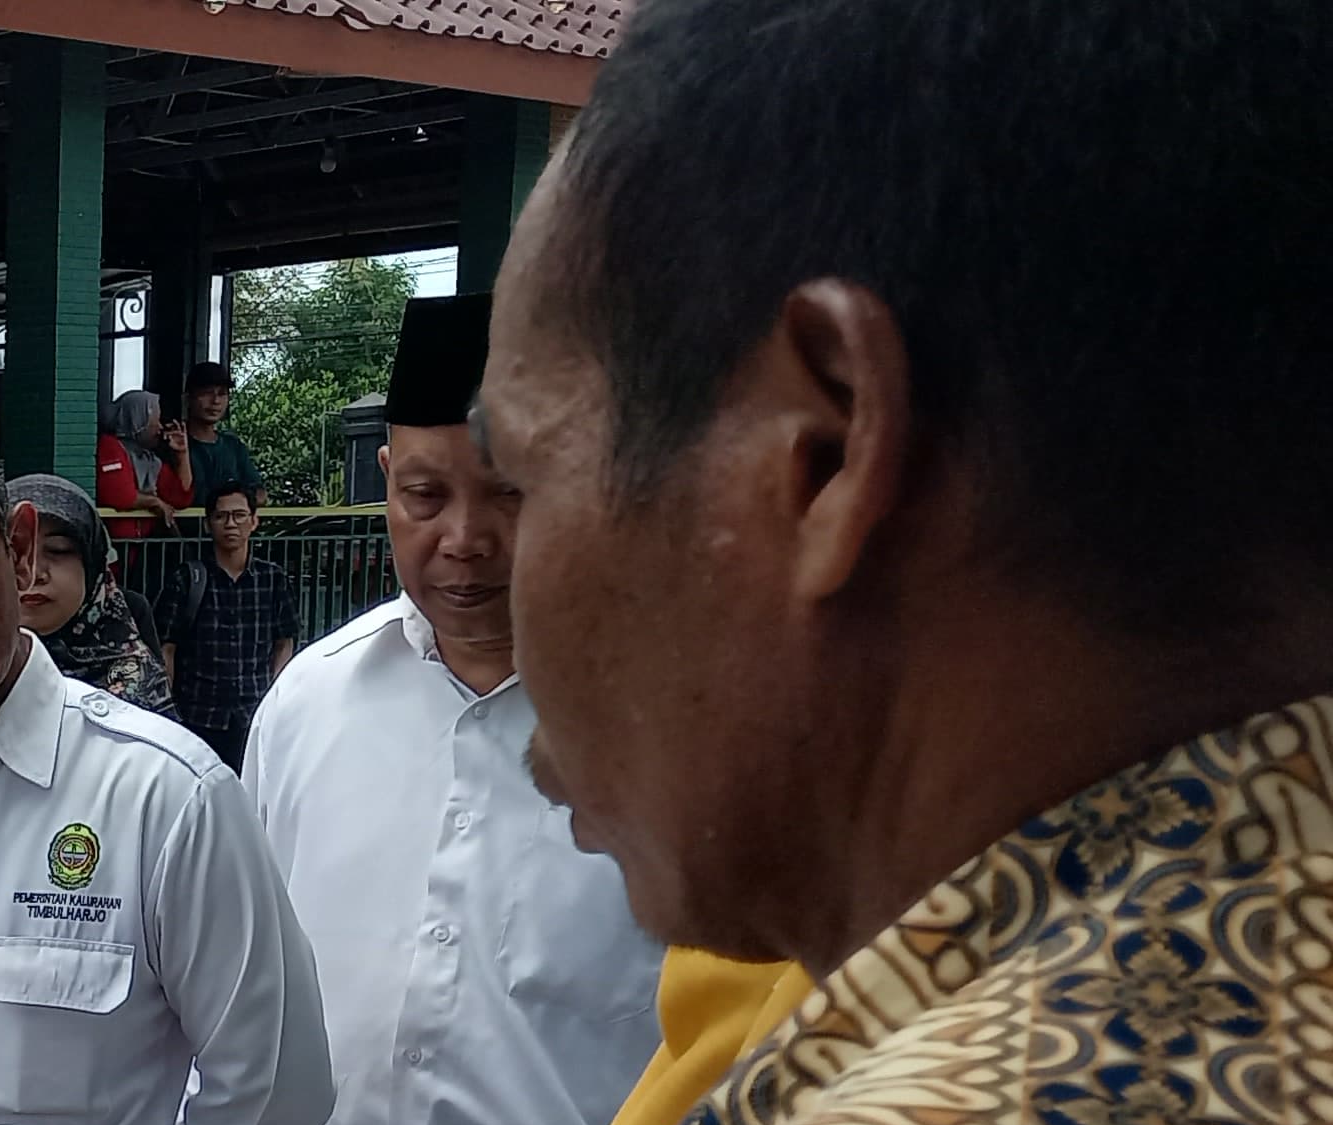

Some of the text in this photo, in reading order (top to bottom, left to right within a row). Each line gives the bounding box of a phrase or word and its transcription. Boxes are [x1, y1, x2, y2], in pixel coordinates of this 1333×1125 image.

[13, 892, 122, 910] PEMERINTAH KALURAHAN
[26, 904, 107, 923] TIMBULHARJO
